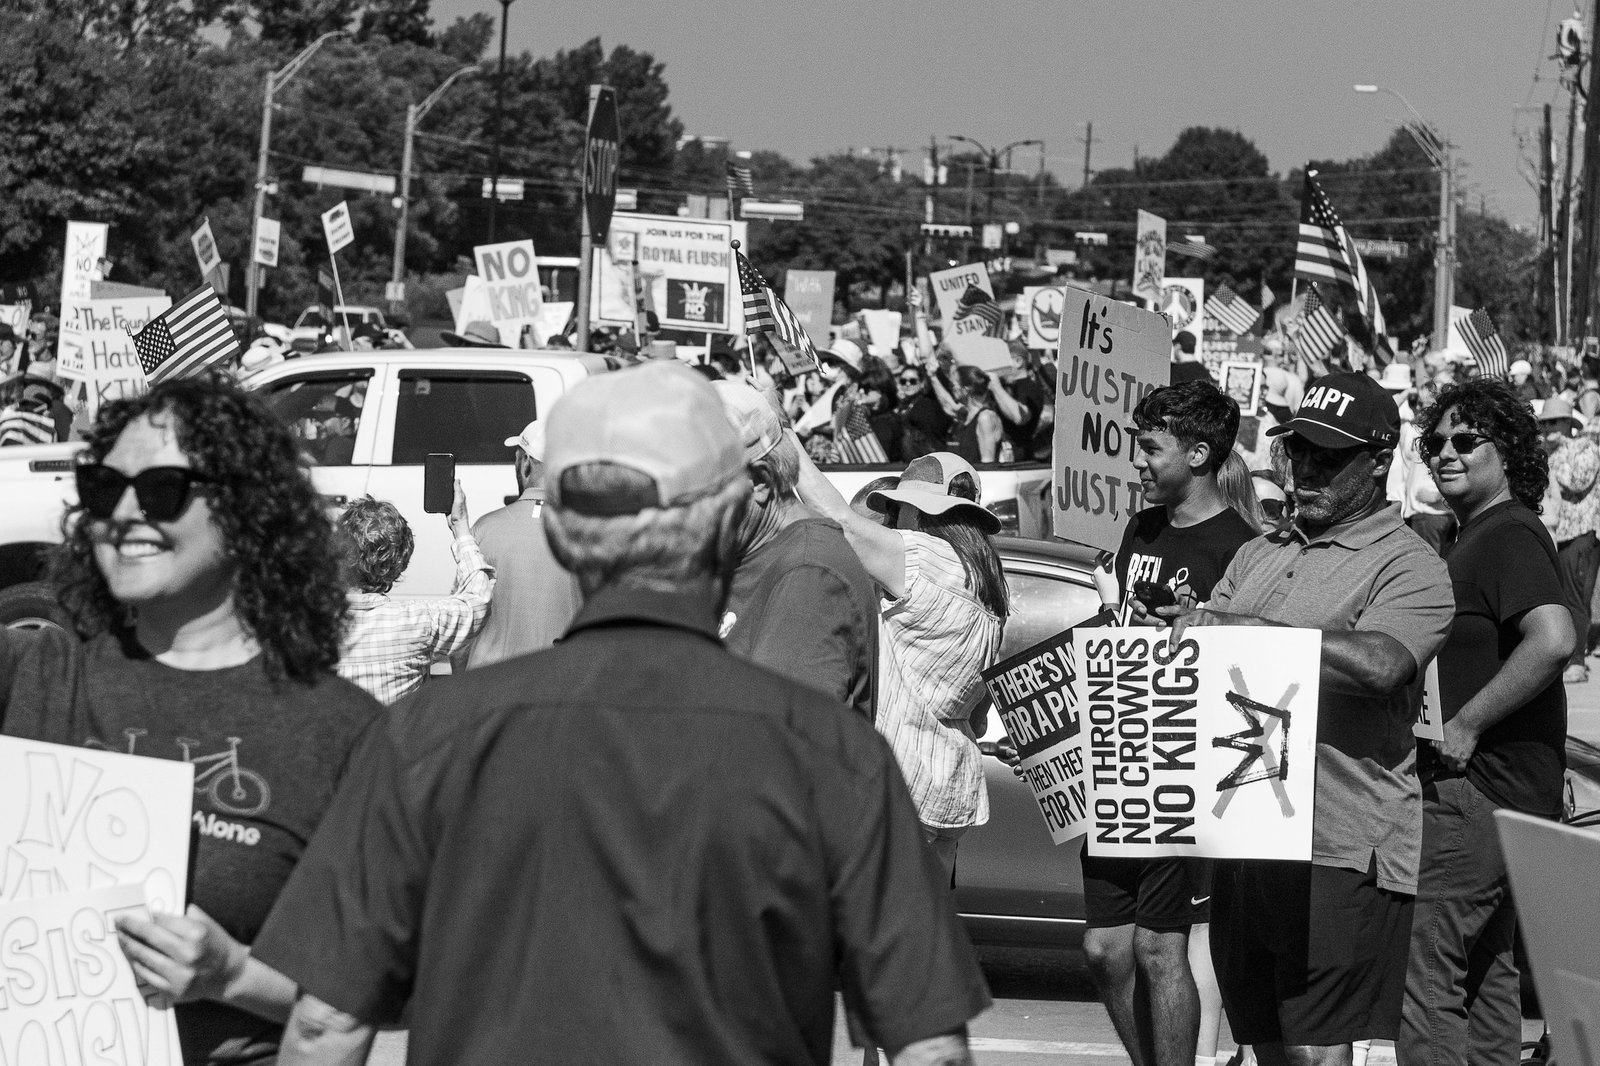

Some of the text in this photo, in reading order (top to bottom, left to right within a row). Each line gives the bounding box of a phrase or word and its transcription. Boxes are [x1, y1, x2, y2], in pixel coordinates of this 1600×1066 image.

[587, 137, 619, 196] STOP
[642, 246, 730, 267] ROYAL FLUSH
[646, 229, 667, 237] JOIN
[685, 232, 703, 240] FOR
[707, 233, 724, 241] THE
[482, 247, 530, 282] NO
[941, 272, 980, 291] UNITED
[80, 307, 110, 331] The
[1080, 299, 1113, 354] It's
[1062, 355, 1168, 413] JUSTI
[1301, 386, 1355, 417] CAPT
[1082, 411, 1142, 462] NOT
[1057, 466, 1119, 521] JUST,
[986, 679, 1002, 711] IF
[994, 651, 1063, 705] THERE'S
[1001, 681, 1080, 749] FOR A PA
[1116, 638, 1149, 787] CROWNS
[1085, 638, 1120, 844] NO THRONES
[1152, 638, 1200, 844] NO KINGS
[1025, 761, 1057, 793] THEN
[17, 751, 149, 865] NO
[1038, 790, 1078, 832] FOR
[1121, 798, 1151, 844] NO
